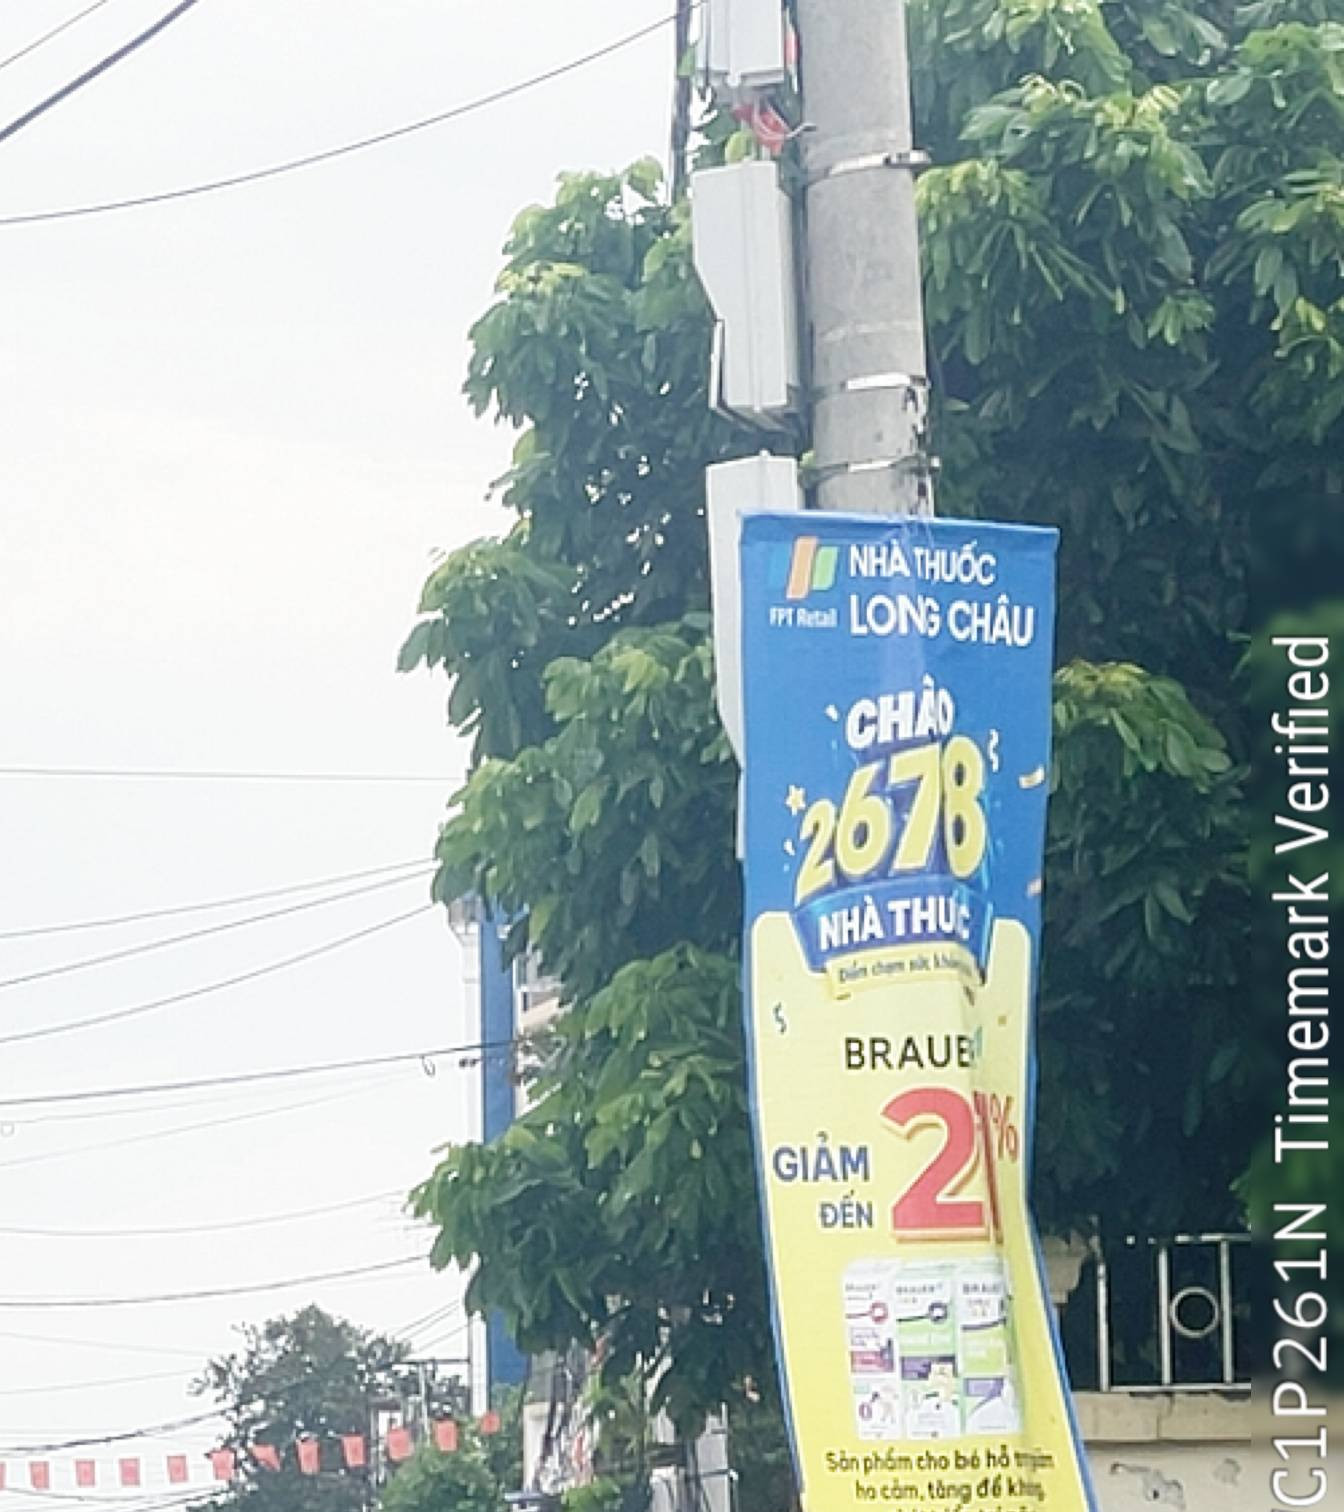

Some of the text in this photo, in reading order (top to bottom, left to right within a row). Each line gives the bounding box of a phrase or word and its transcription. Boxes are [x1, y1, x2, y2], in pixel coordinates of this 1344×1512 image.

[849, 540, 997, 586] NHÀ THUỐC
[849, 594, 1034, 647] LONG CHÂU
[845, 674, 955, 750] CHÀO
[794, 735, 988, 908] 2678
[819, 905, 884, 950] NHÀ
[772, 1131, 871, 1182] GIẢM
[819, 1190, 874, 1229] ĐẾN
[916, 1450, 950, 1470] cho
